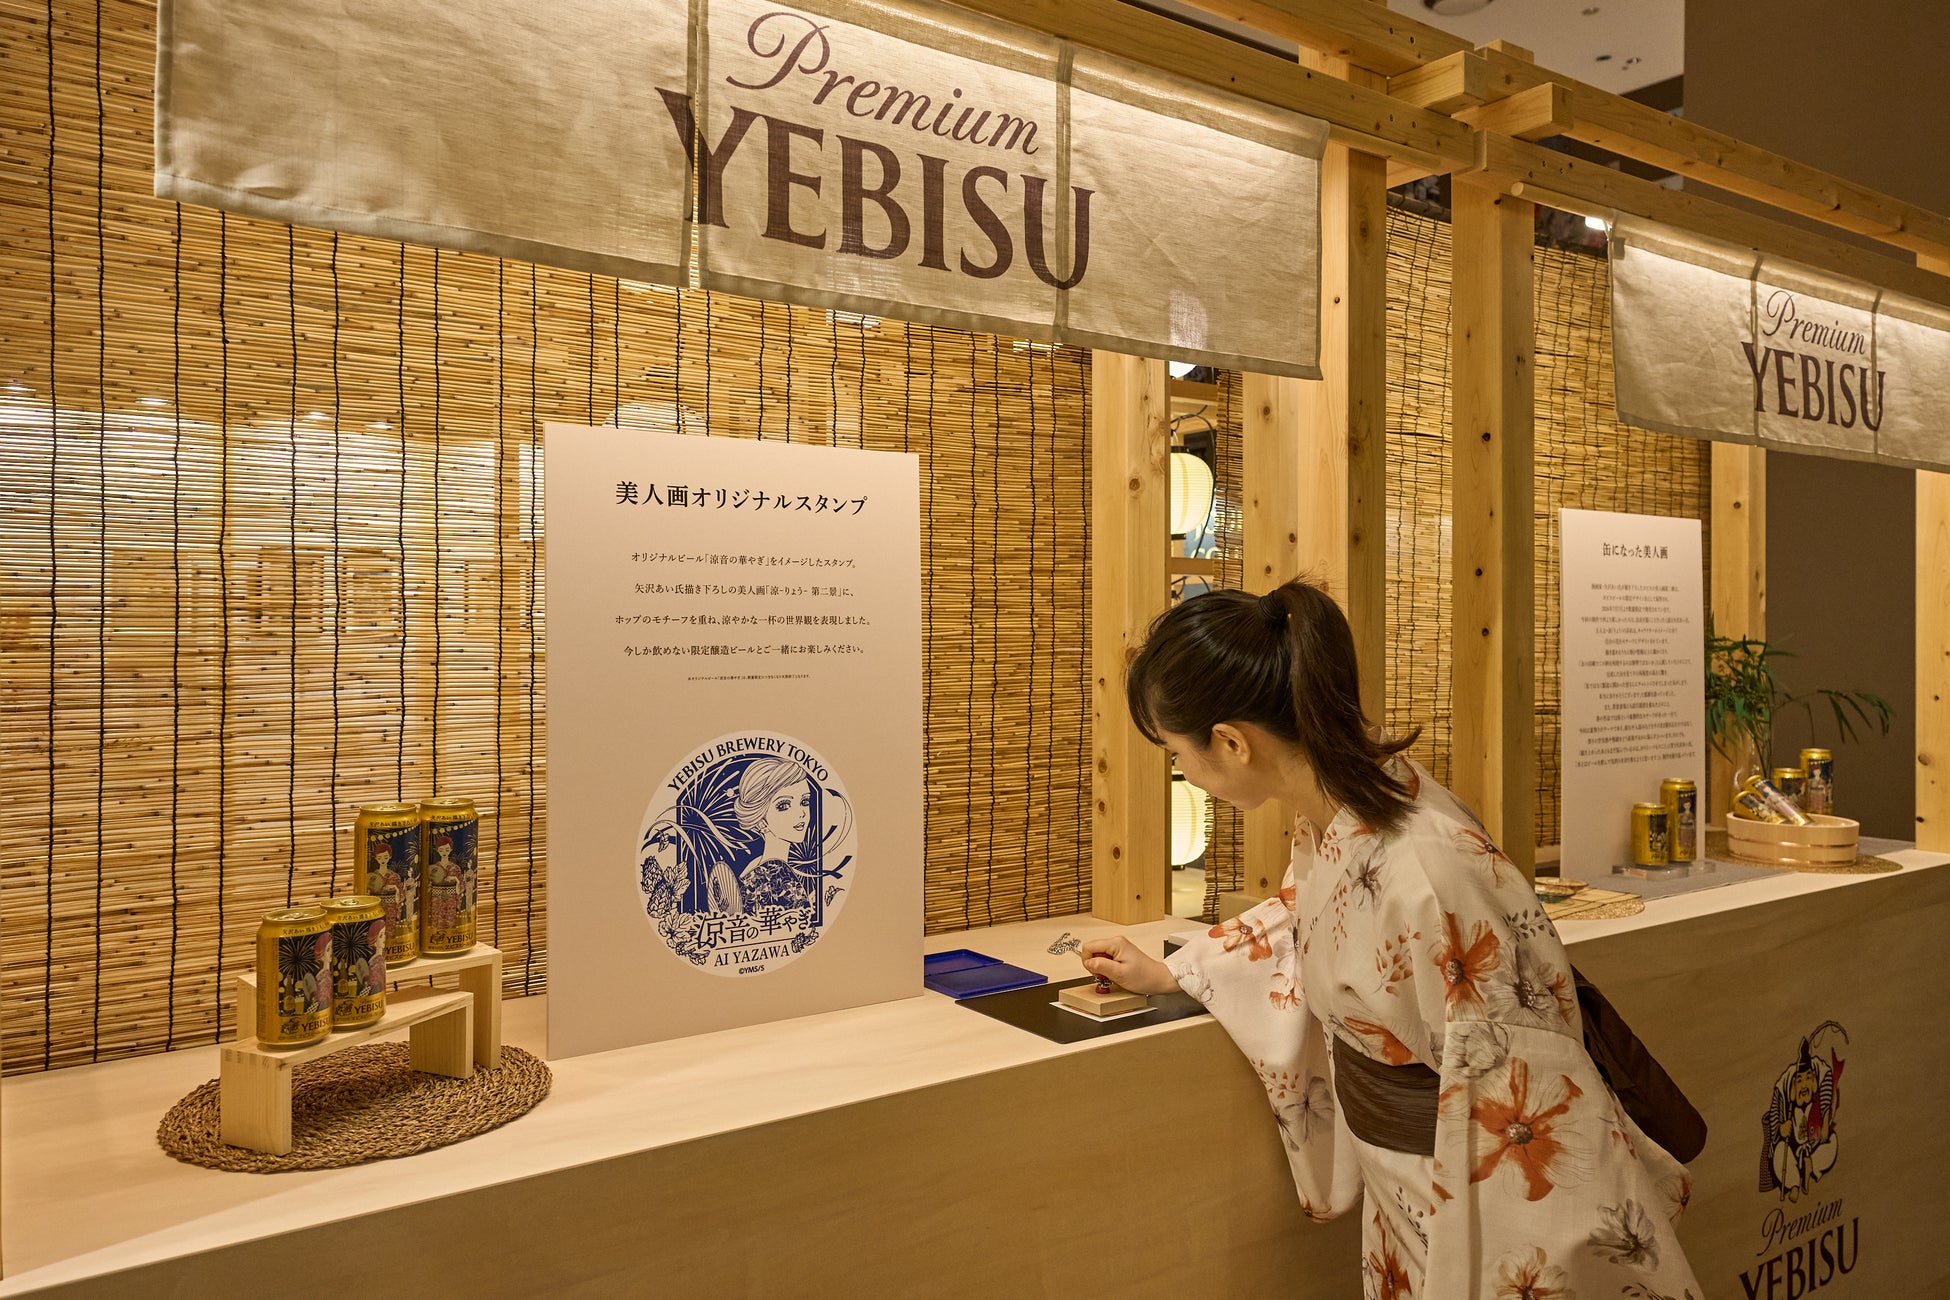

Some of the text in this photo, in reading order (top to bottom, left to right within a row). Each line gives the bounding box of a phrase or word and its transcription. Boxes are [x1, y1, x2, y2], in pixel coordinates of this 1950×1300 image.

[725, 11, 1040, 156] Premium
[654, 86, 1096, 291] YEBISU
[1763, 290, 1866, 355] Premium
[1740, 341, 1886, 432] YEBISU
[615, 480, 868, 516] 美人画オリジナルスタンプ
[667, 737, 829, 793] YEBISU BREWERY TOKYO
[385, 942, 415, 955] YEBISU
[446, 932, 475, 945] YEBISU
[714, 945, 790, 967] AI YAZAWA
[301, 1016, 330, 1032] YEBISU
[354, 999, 383, 1015] YEBISU
[1757, 1199, 1843, 1256] Premium
[1738, 1217, 1859, 1300] YEBISU
